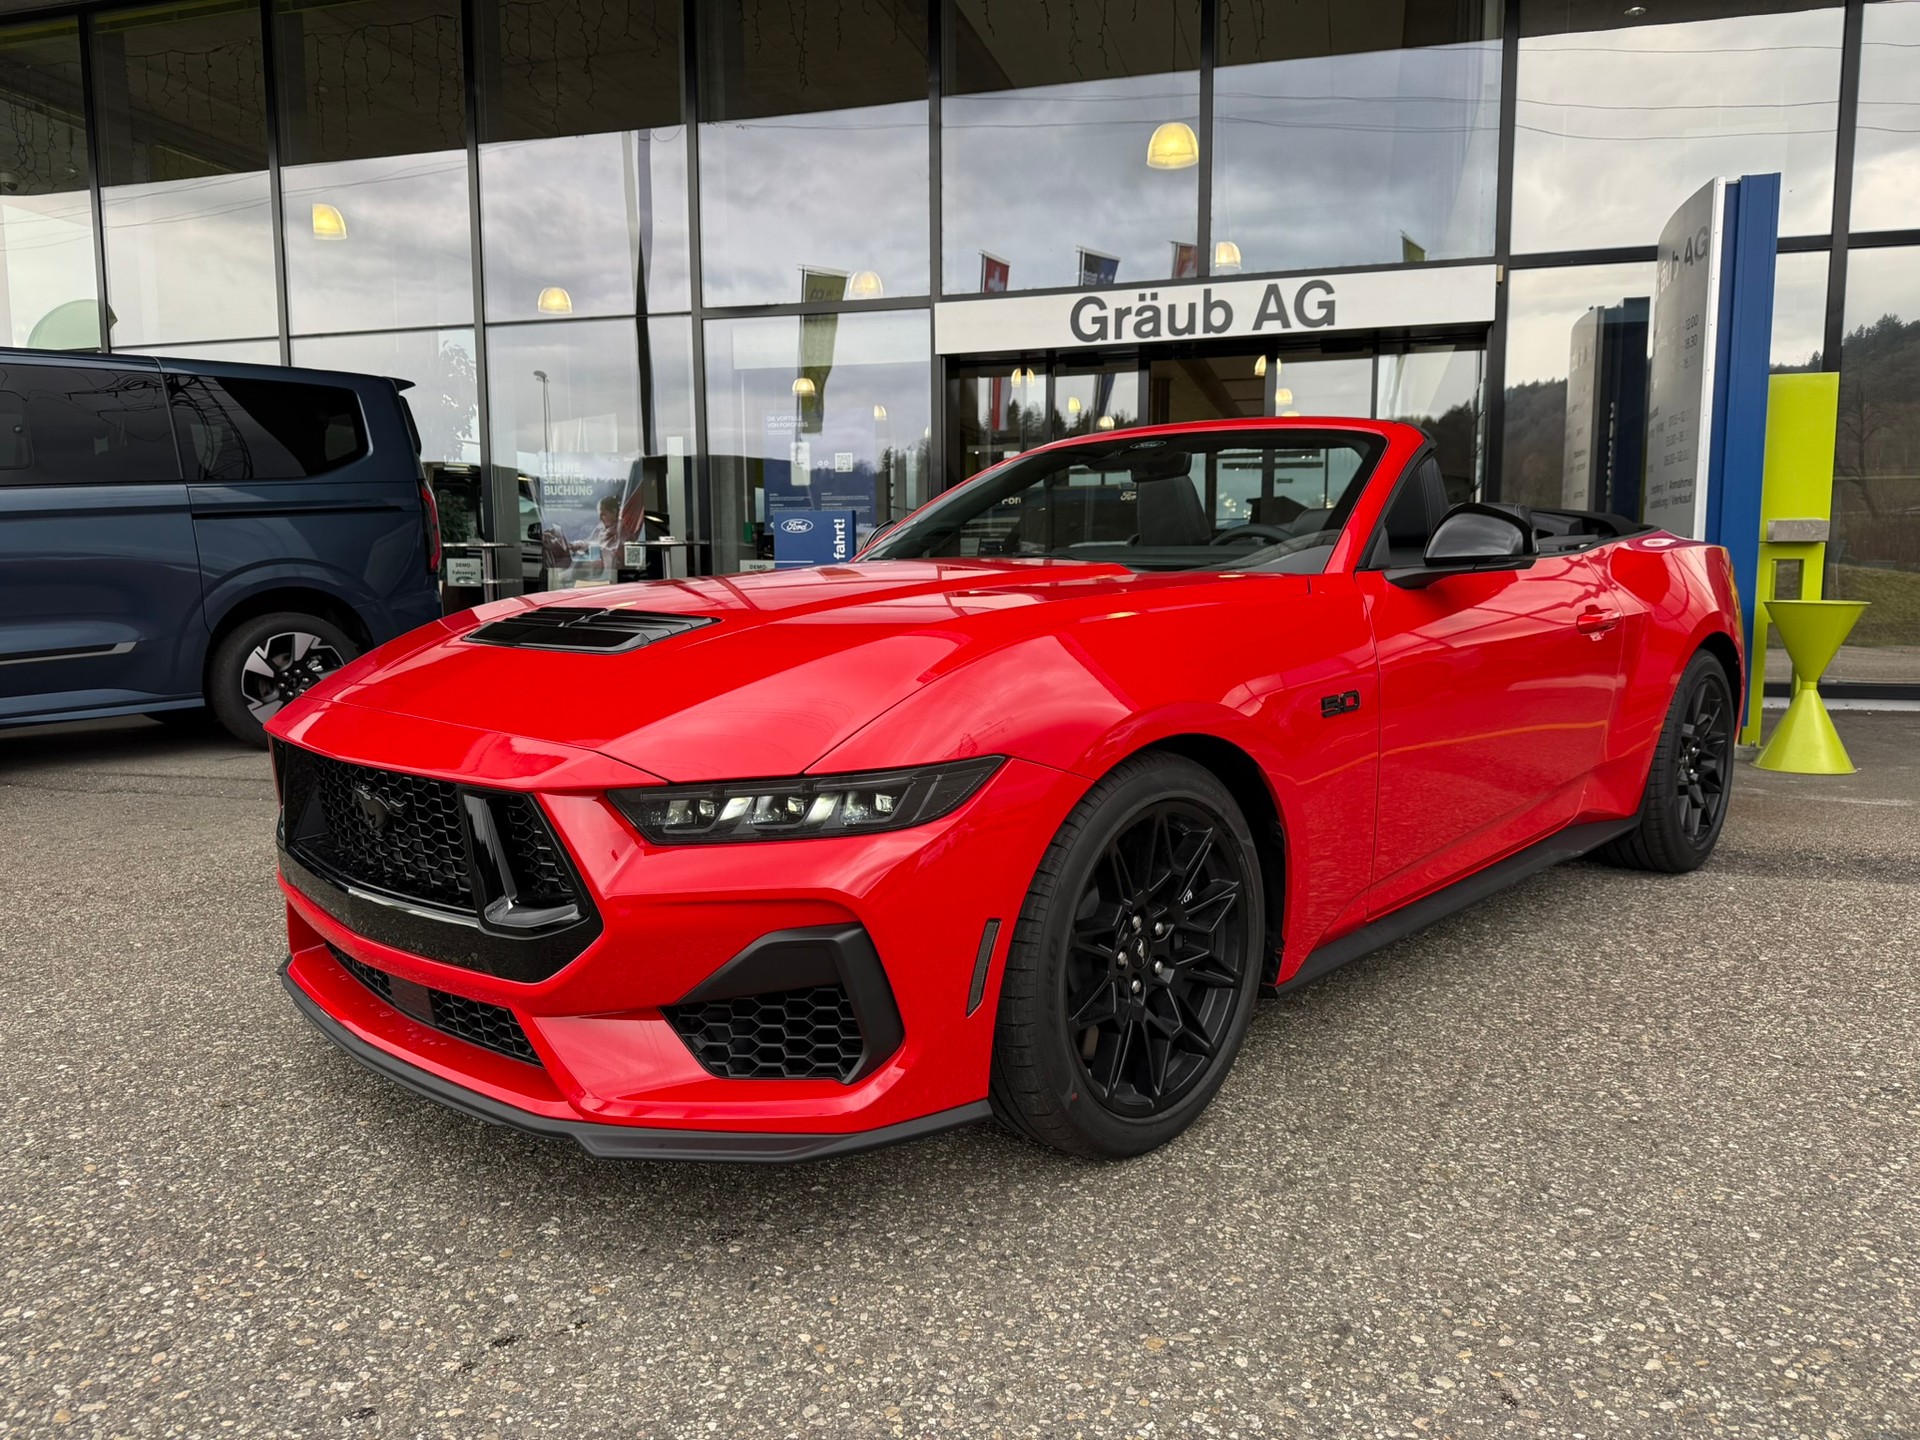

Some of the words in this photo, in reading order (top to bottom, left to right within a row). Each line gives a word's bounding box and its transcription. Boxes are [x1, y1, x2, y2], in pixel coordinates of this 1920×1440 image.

[1684, 226, 1709, 266] AG
[1070, 288, 1234, 343] Gräub
[1252, 279, 1336, 331] AG
[543, 462, 580, 472] ONLINE
[543, 474, 586, 484] SERVICE
[544, 485, 593, 496] BUCHUNG
[1671, 492, 1693, 505] Verkauf
[786, 520, 808, 531] Ford
[833, 518, 846, 560] fahrt!
